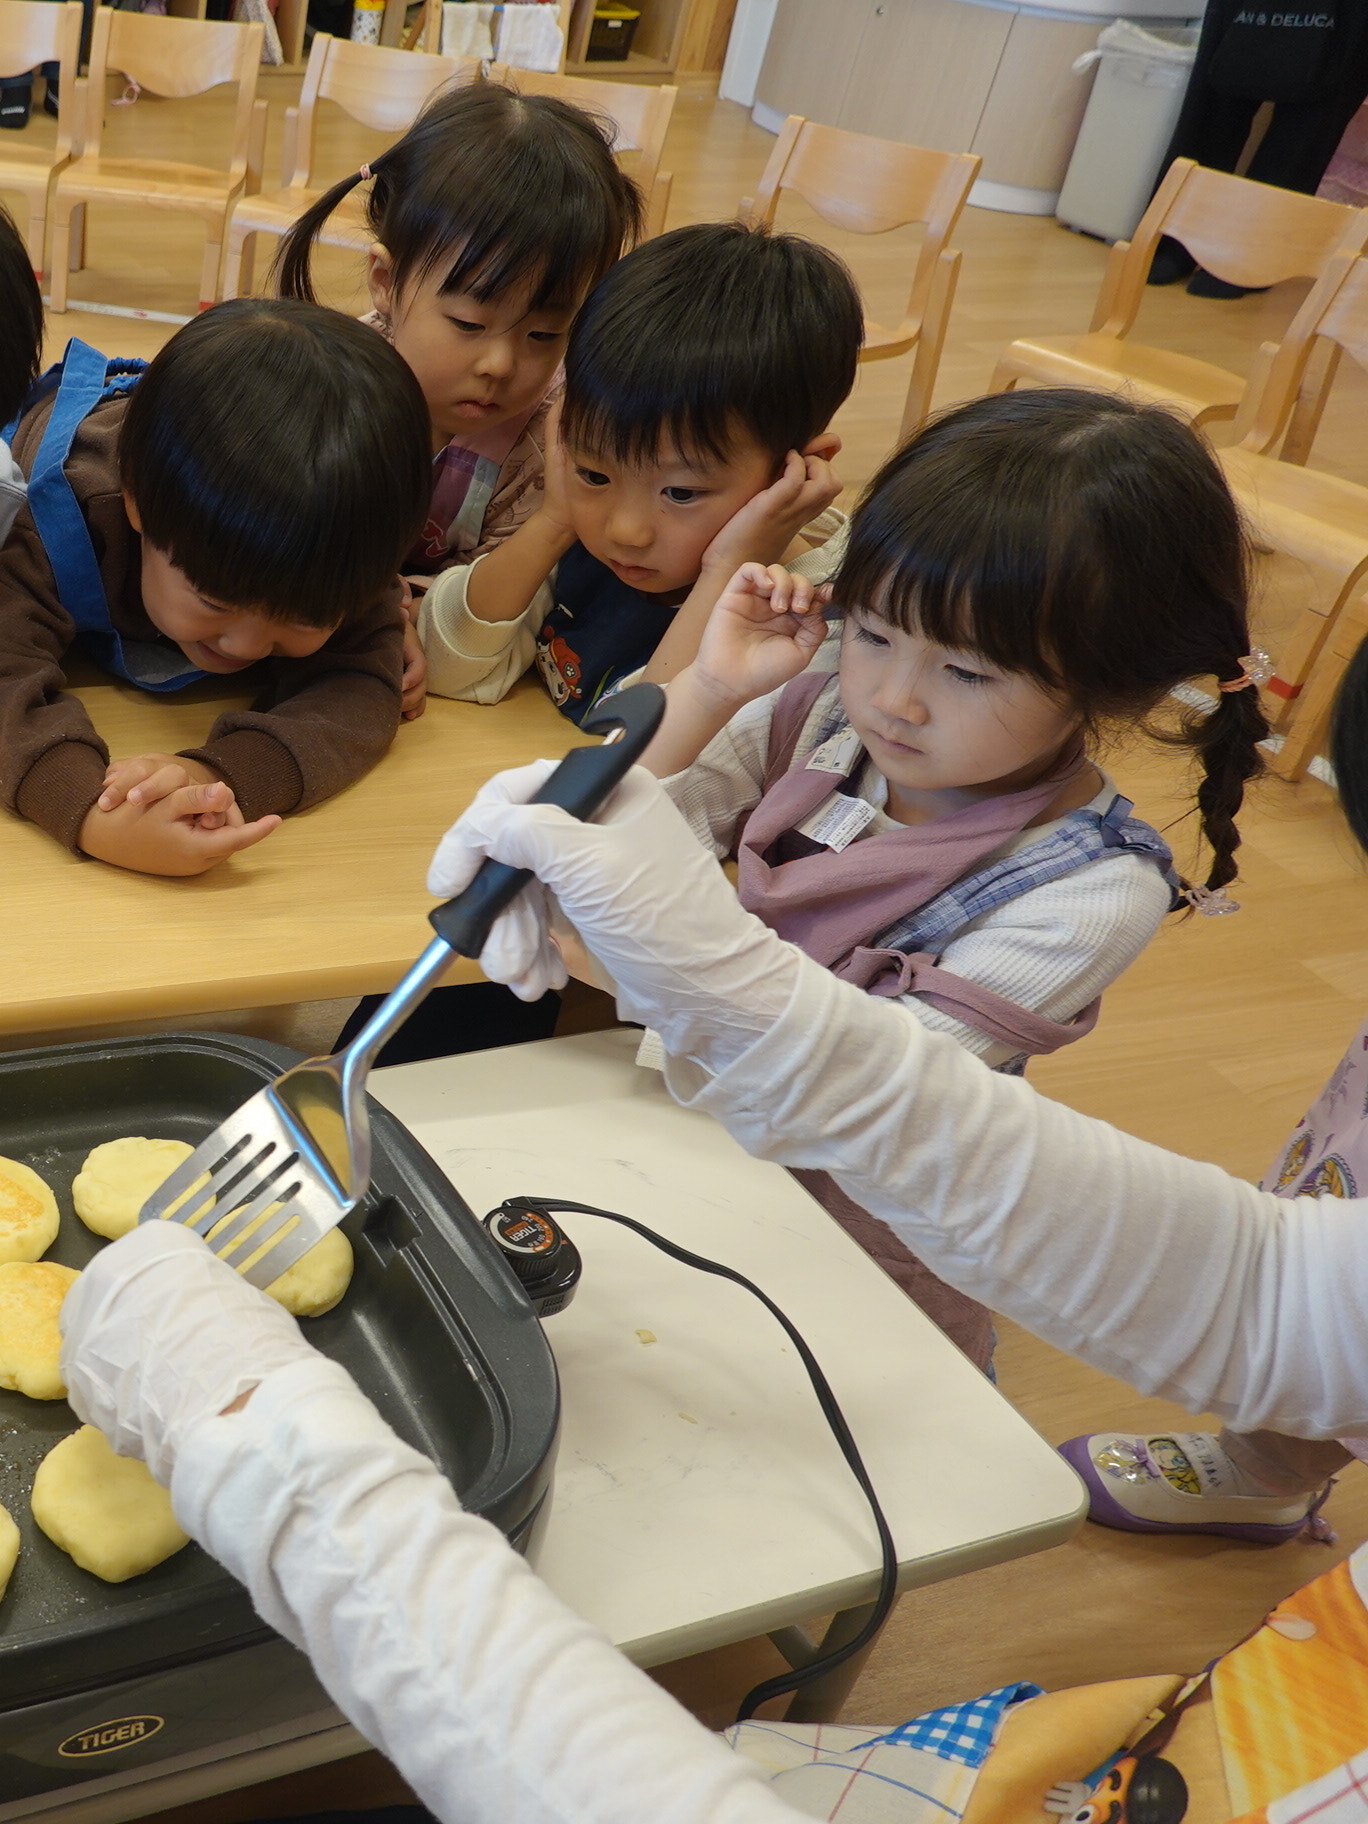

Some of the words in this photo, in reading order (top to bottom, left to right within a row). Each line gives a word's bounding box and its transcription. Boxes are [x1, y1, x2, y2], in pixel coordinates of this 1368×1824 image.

[1270, 12, 1335, 28] DELUCA
[509, 1226, 537, 1242] TIGER
[78, 1722, 145, 1749] TIGER
